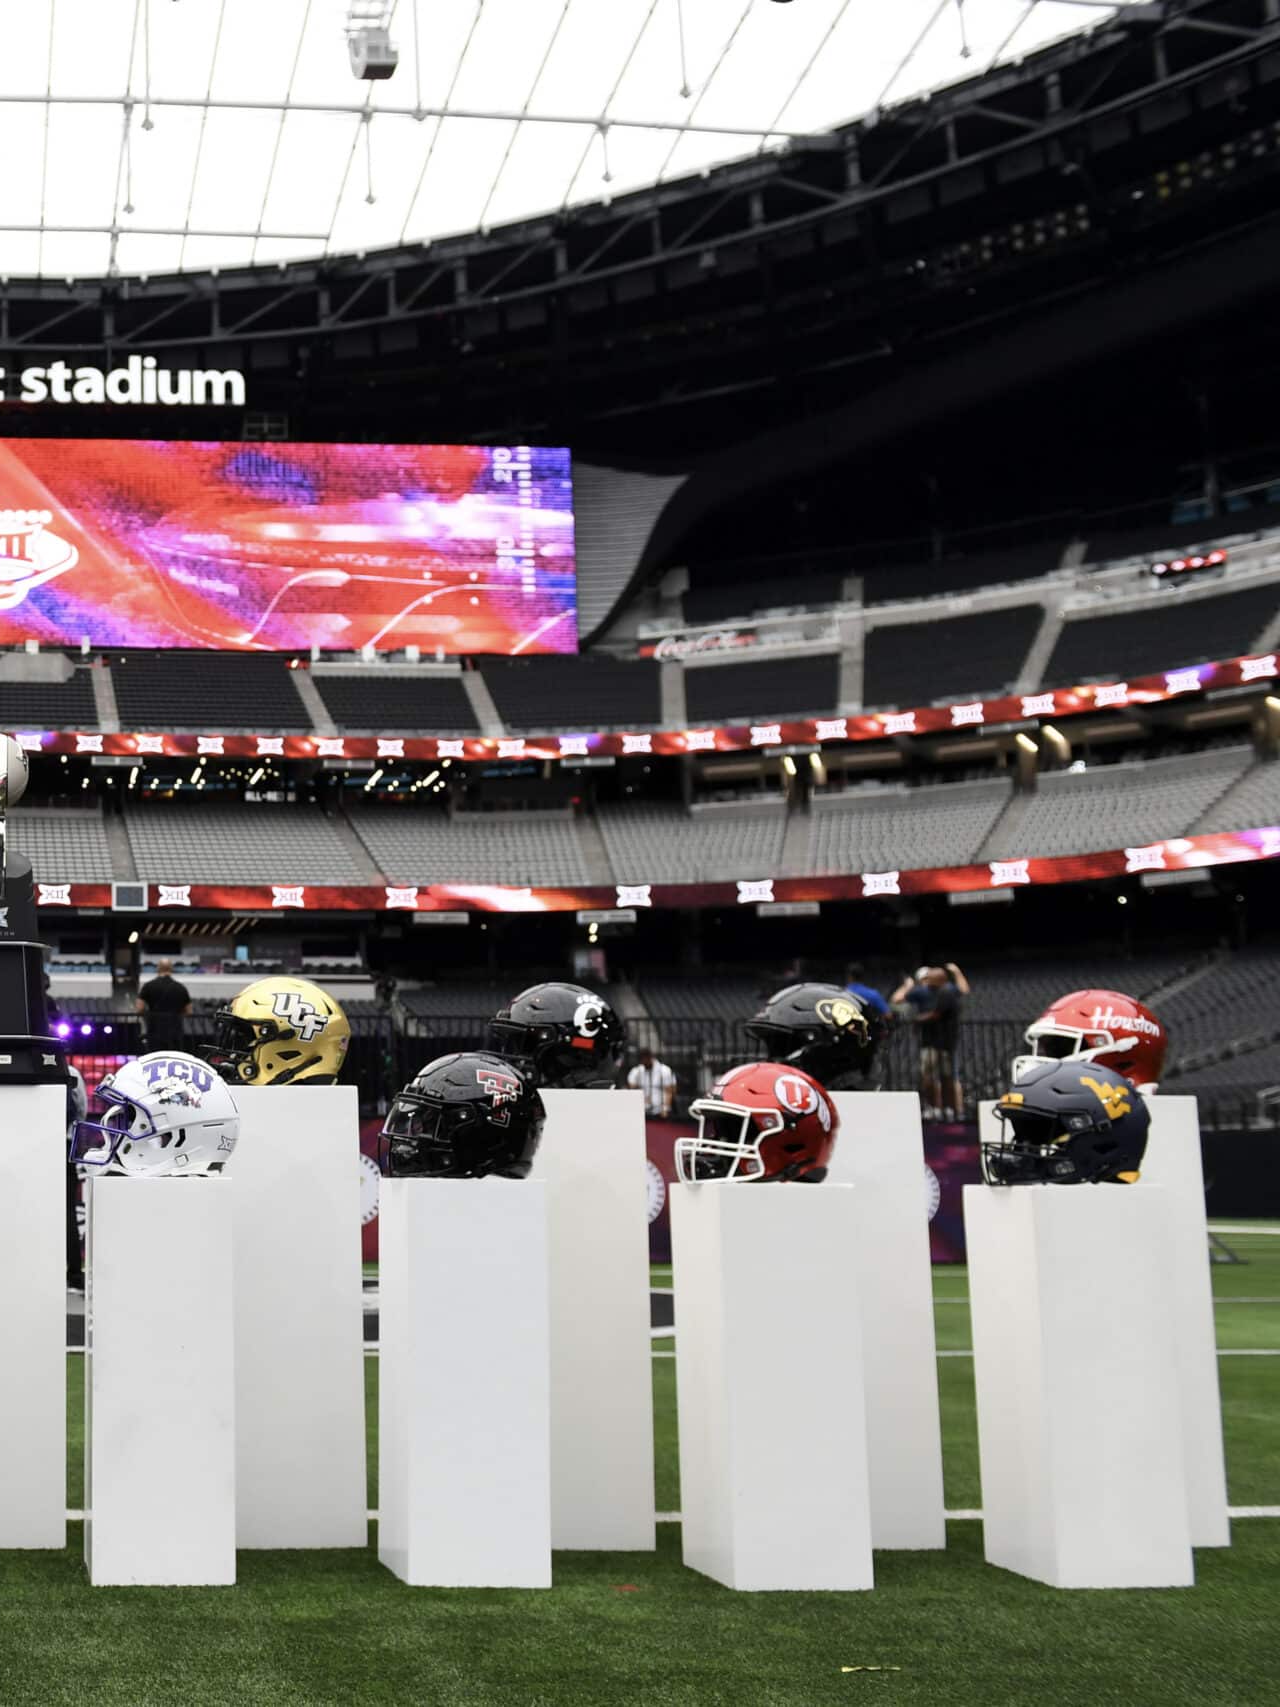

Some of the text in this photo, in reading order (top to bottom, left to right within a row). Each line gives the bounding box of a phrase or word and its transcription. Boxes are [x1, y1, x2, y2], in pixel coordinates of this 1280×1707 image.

[21, 355, 246, 406] stadium
[272, 993, 329, 1041] UCF
[1090, 1006, 1160, 1038] Houston
[143, 1061, 213, 1093] TCU
